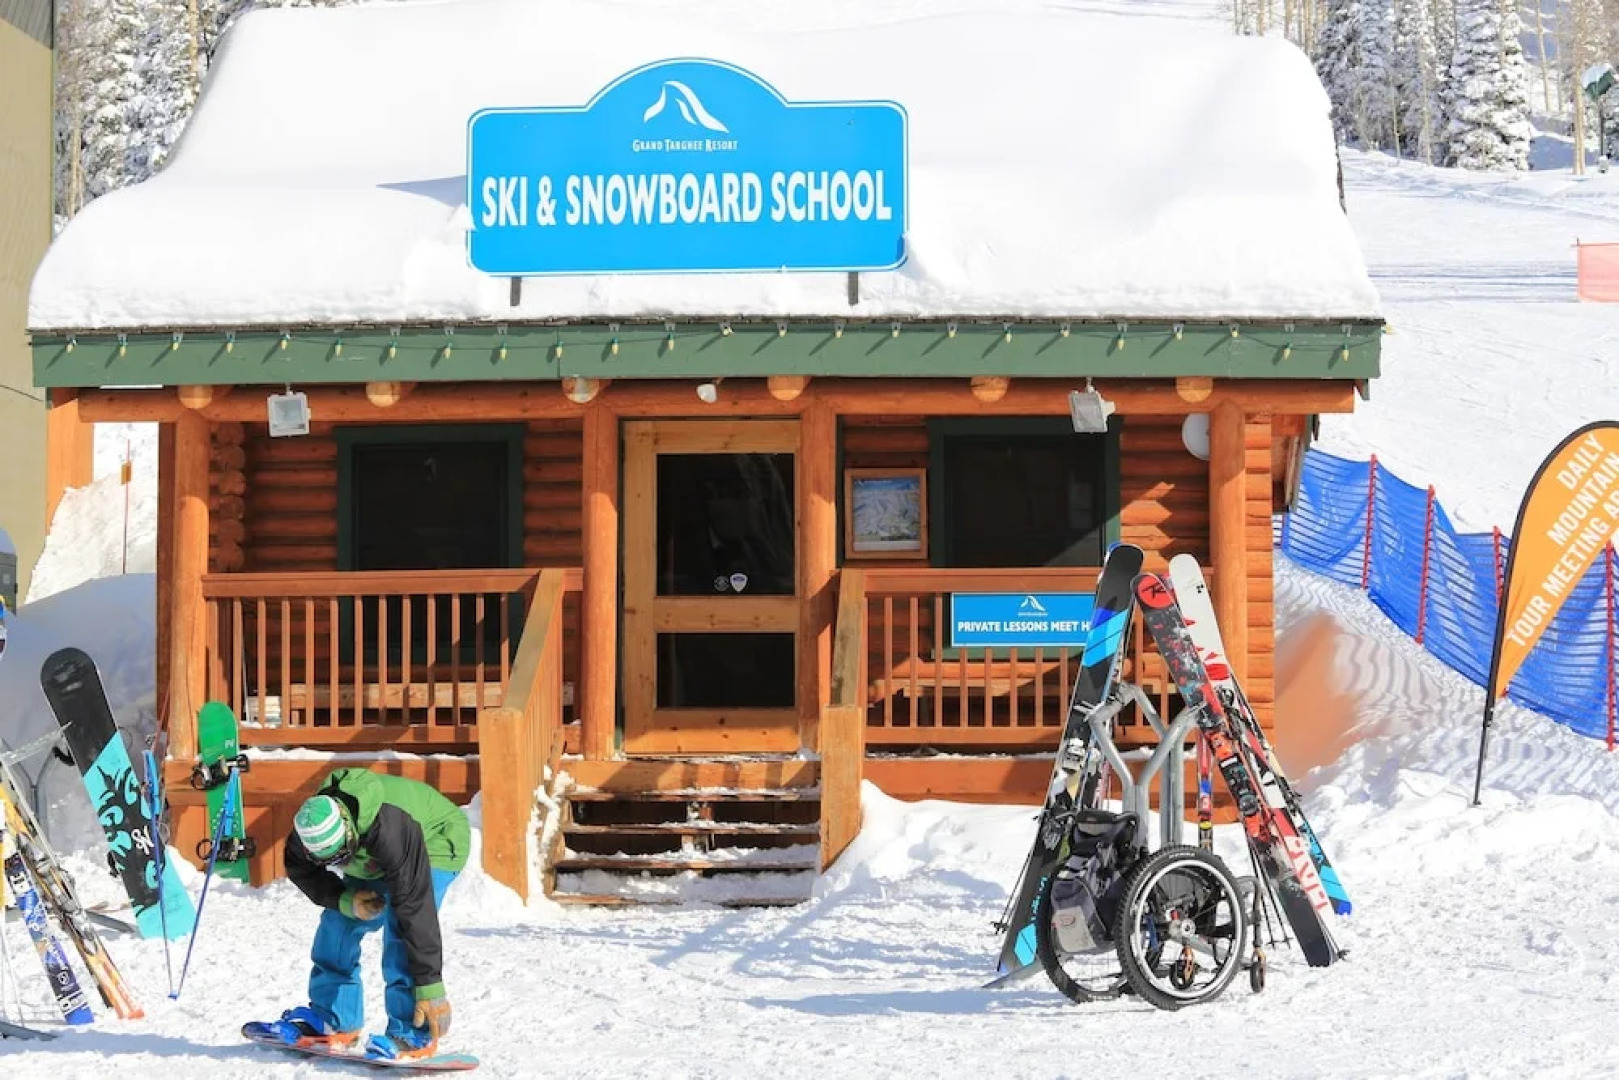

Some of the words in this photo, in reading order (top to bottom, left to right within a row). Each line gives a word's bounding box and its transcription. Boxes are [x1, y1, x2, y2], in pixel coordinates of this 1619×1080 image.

[632, 139, 663, 152] GRAND
[482, 175, 528, 226] SKI
[536, 174, 557, 226] &
[566, 171, 762, 226] SNOWBOARD
[771, 169, 892, 222] SCHOOL
[1556, 433, 1605, 490] DAILY
[1546, 452, 1619, 546] MOUNTAIN
[1507, 595, 1551, 647] TOUR
[1542, 517, 1611, 598] MEETING
[957, 621, 1001, 632] PRIVATE
[1003, 621, 1048, 632] LESSONS
[1051, 621, 1078, 632] MEET
